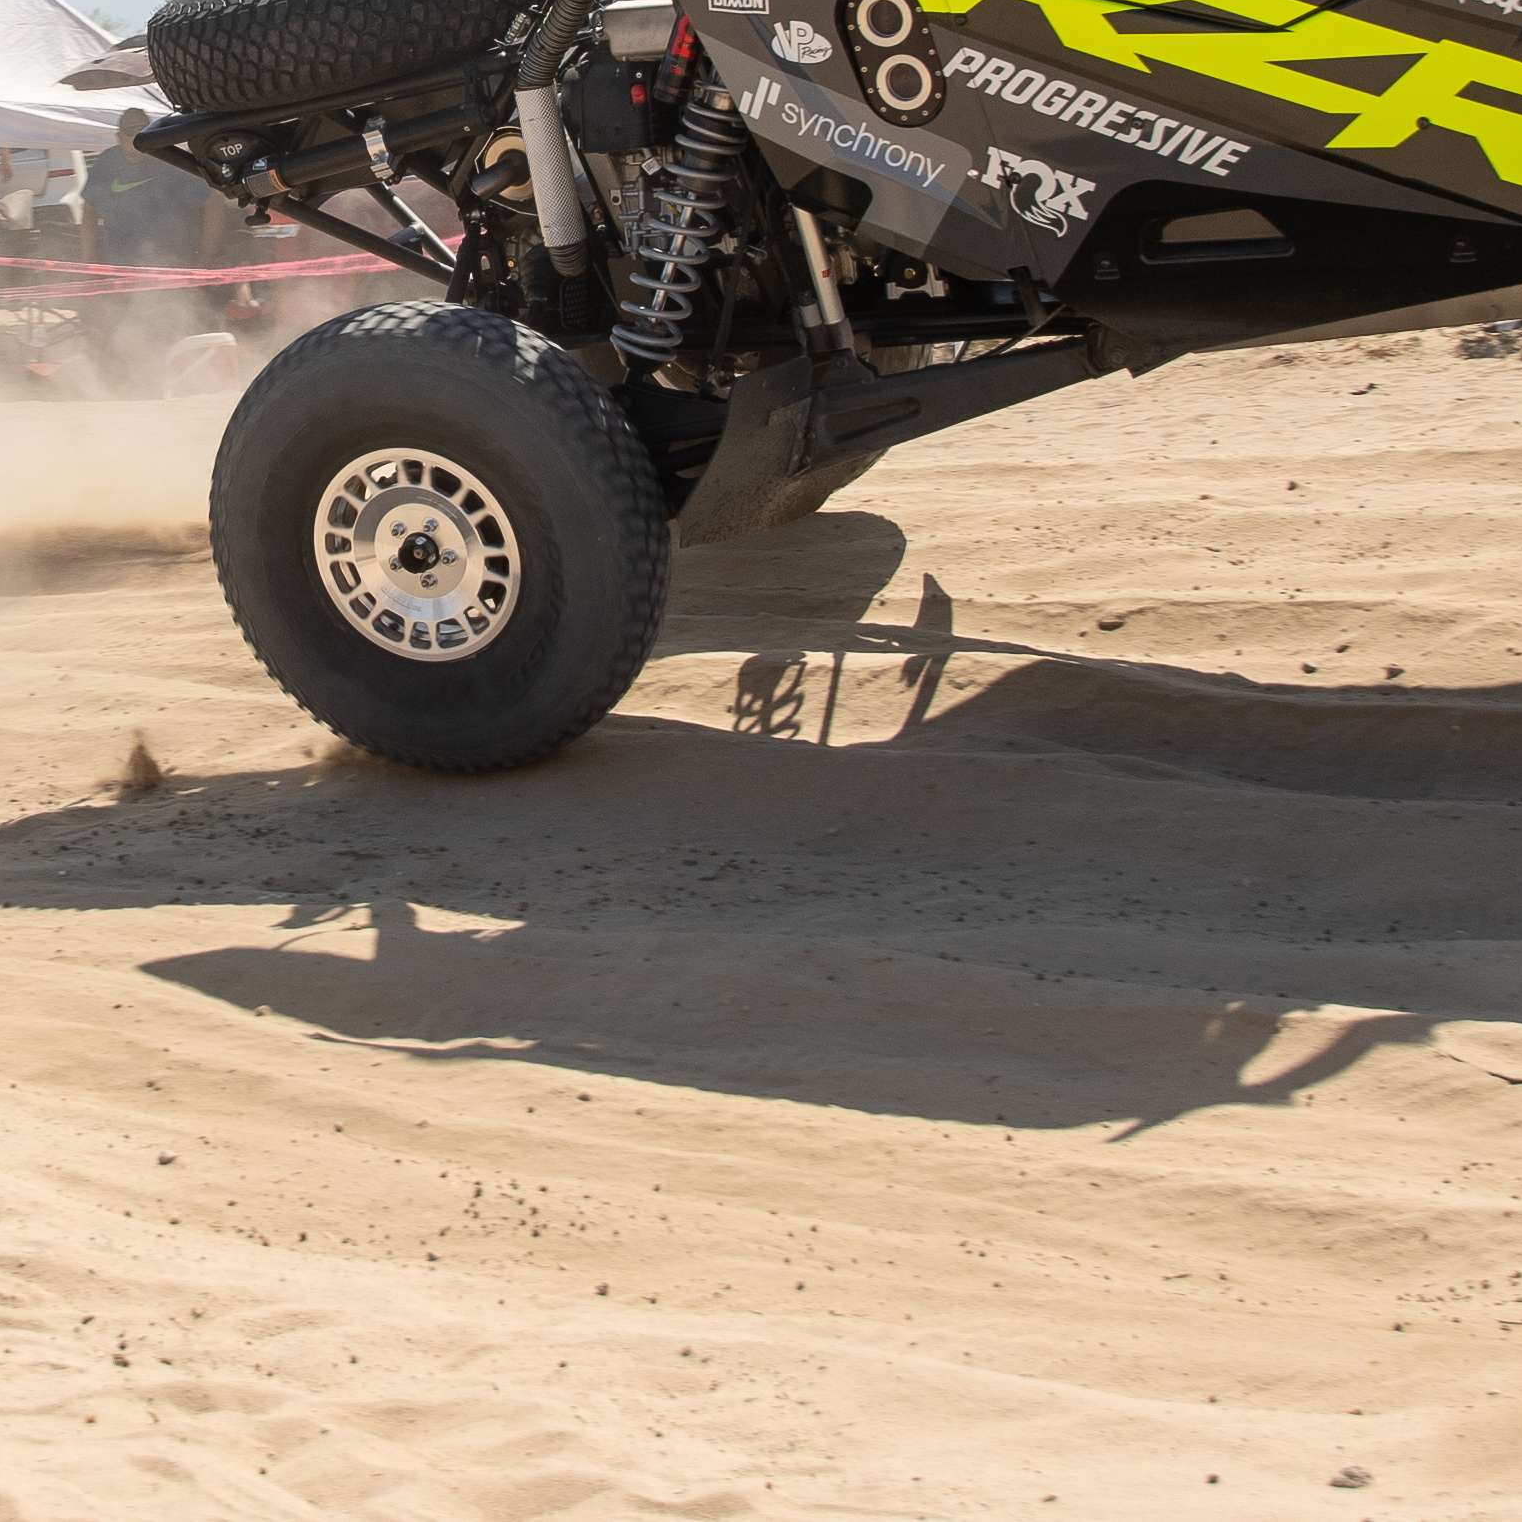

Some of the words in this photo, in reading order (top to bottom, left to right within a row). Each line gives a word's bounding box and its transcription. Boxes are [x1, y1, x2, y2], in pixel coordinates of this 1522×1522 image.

[774, 20, 814, 63] VP
[219, 143, 243, 157] TOP
[781, 102, 946, 188] synchrony
[942, 47, 1251, 177] PROGRESSIVE
[981, 146, 1097, 238] FOX
